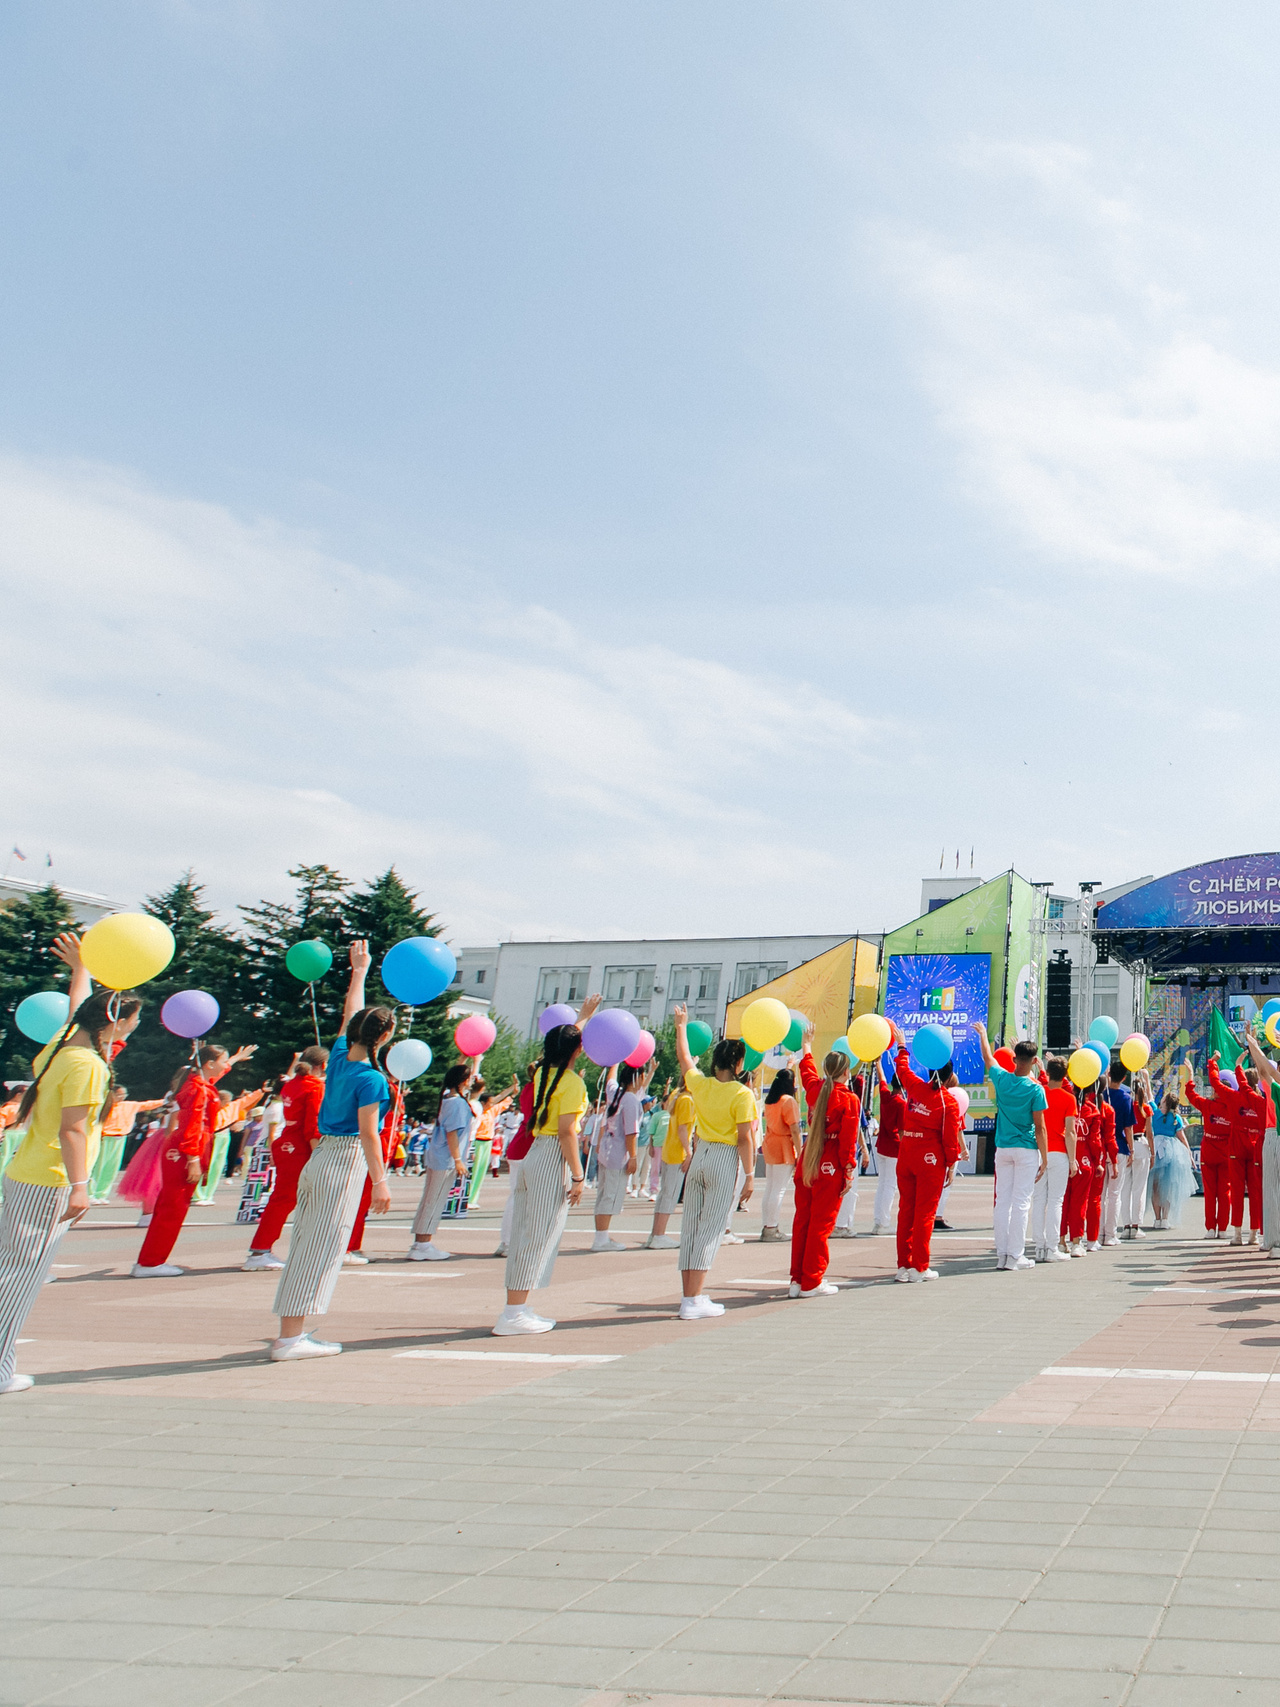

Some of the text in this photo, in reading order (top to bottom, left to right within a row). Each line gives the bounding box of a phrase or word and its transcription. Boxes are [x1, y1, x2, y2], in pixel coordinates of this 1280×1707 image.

[1188, 879, 1201, 893] С
[1205, 875, 1260, 894] ДНЁМ
[904, 1013, 968, 1025] УЛАН-УДЭ
